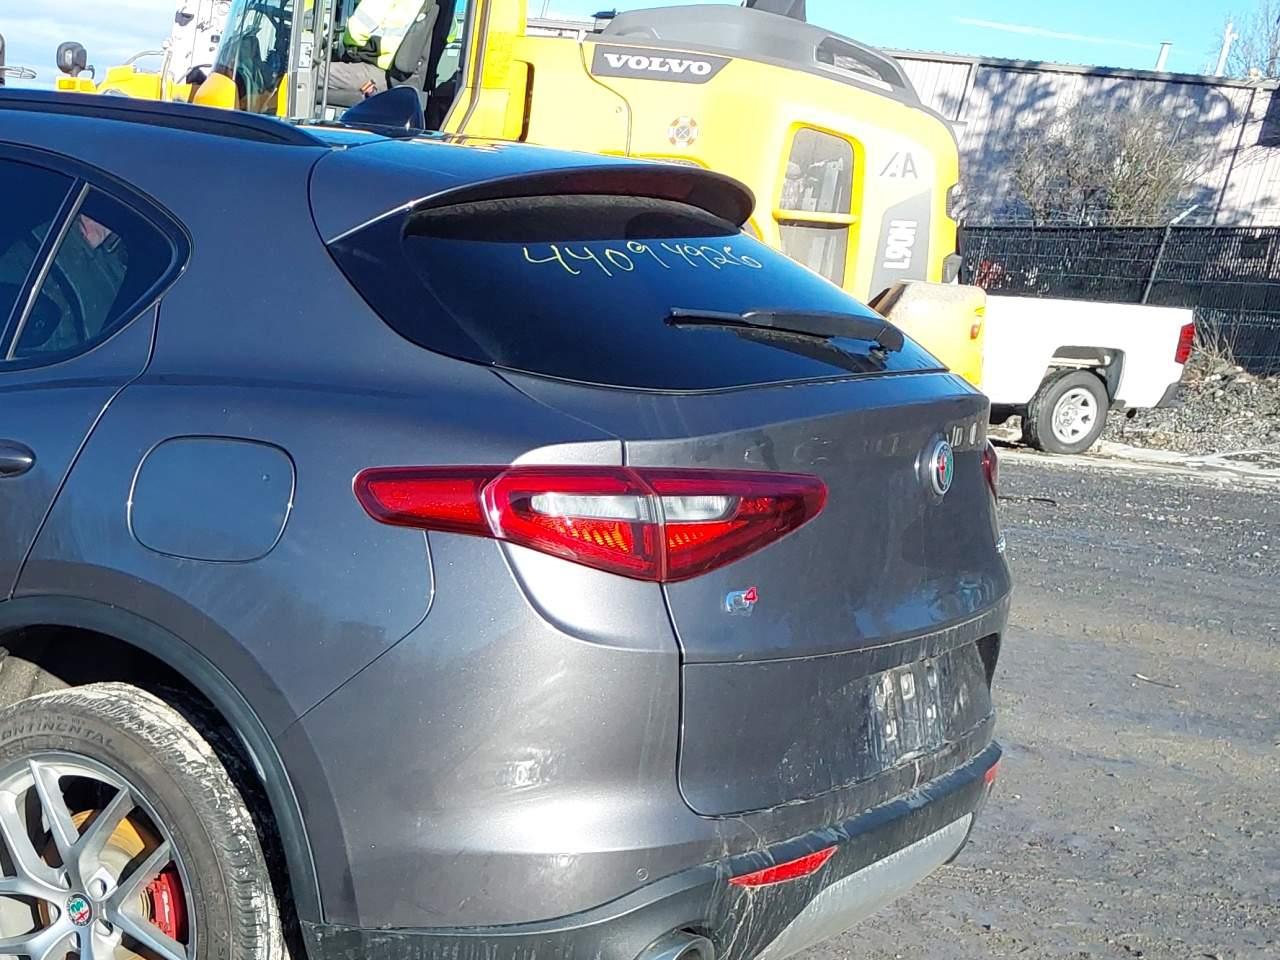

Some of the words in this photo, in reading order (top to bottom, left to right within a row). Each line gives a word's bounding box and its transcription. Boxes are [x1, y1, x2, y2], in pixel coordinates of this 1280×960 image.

[603, 53, 712, 76] VOLVO
[522, 241, 763, 277] 44094926
[882, 220, 918, 269] L90H
